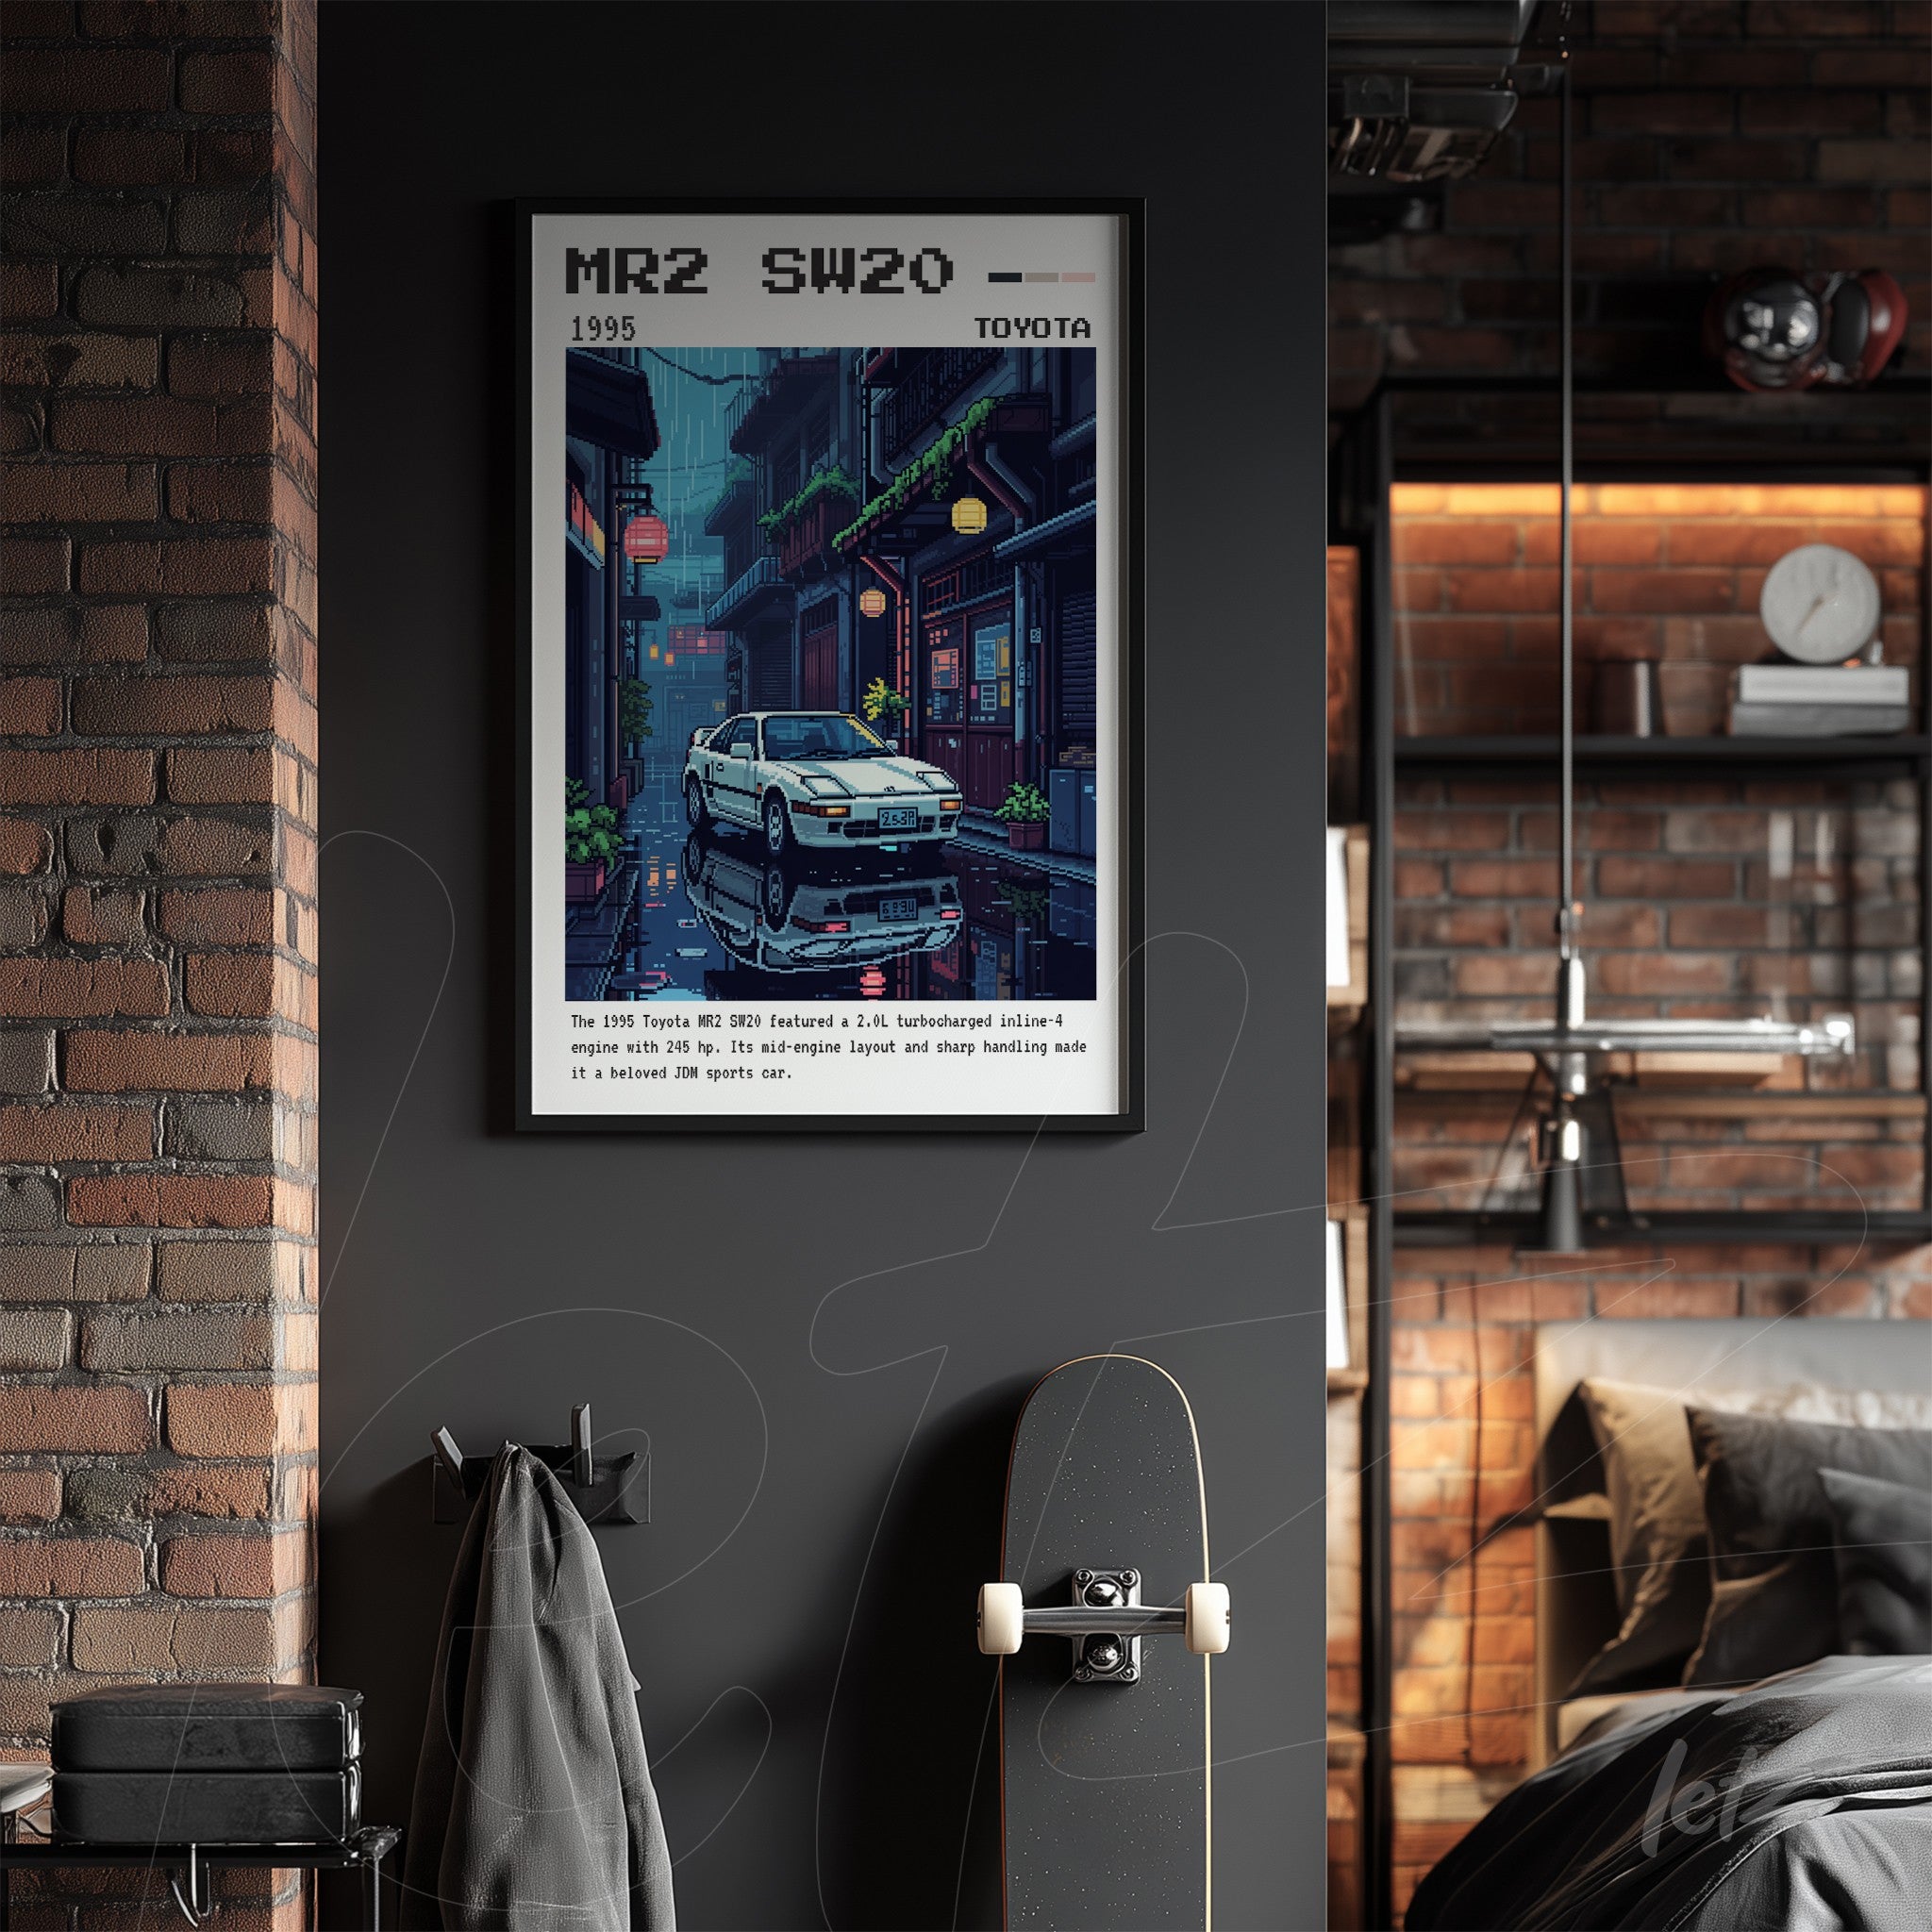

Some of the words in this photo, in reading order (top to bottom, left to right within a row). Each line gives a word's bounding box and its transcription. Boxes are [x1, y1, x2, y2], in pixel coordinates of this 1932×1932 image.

[566, 247, 708, 294] MR2
[761, 247, 954, 294] SW20
[572, 315, 636, 341] 1995
[974, 317, 1091, 339] TOYOTA
[571, 1014, 595, 1027] The
[603, 1014, 635, 1027] 1995
[642, 1014, 691, 1031] Toyota
[698, 1014, 722, 1027] MR2
[729, 1014, 761, 1027] SW20
[770, 1014, 834, 1027] featured
[841, 1017, 849, 1027] a
[857, 1014, 889, 1027] 2.0L
[896, 1014, 992, 1031] turbocharged
[1000, 1014, 1063, 1027] inline-4
[571, 1040, 619, 1058] engine
[626, 1040, 658, 1054] with
[666, 1040, 691, 1054] 245
[698, 1040, 720, 1058] hp.
[731, 1040, 754, 1054] Its
[761, 1040, 841, 1058] mid-engine
[849, 1040, 896, 1058] layout
[904, 1040, 928, 1054] and
[936, 1040, 976, 1058] sharp
[983, 1040, 1047, 1058] handling
[1055, 1040, 1087, 1054] made
[572, 1066, 587, 1079] it
[594, 1069, 603, 1079] a
[610, 1066, 667, 1079] beloved
[674, 1066, 698, 1079] JDM
[706, 1066, 754, 1083] sports
[761, 1069, 791, 1079] car.
